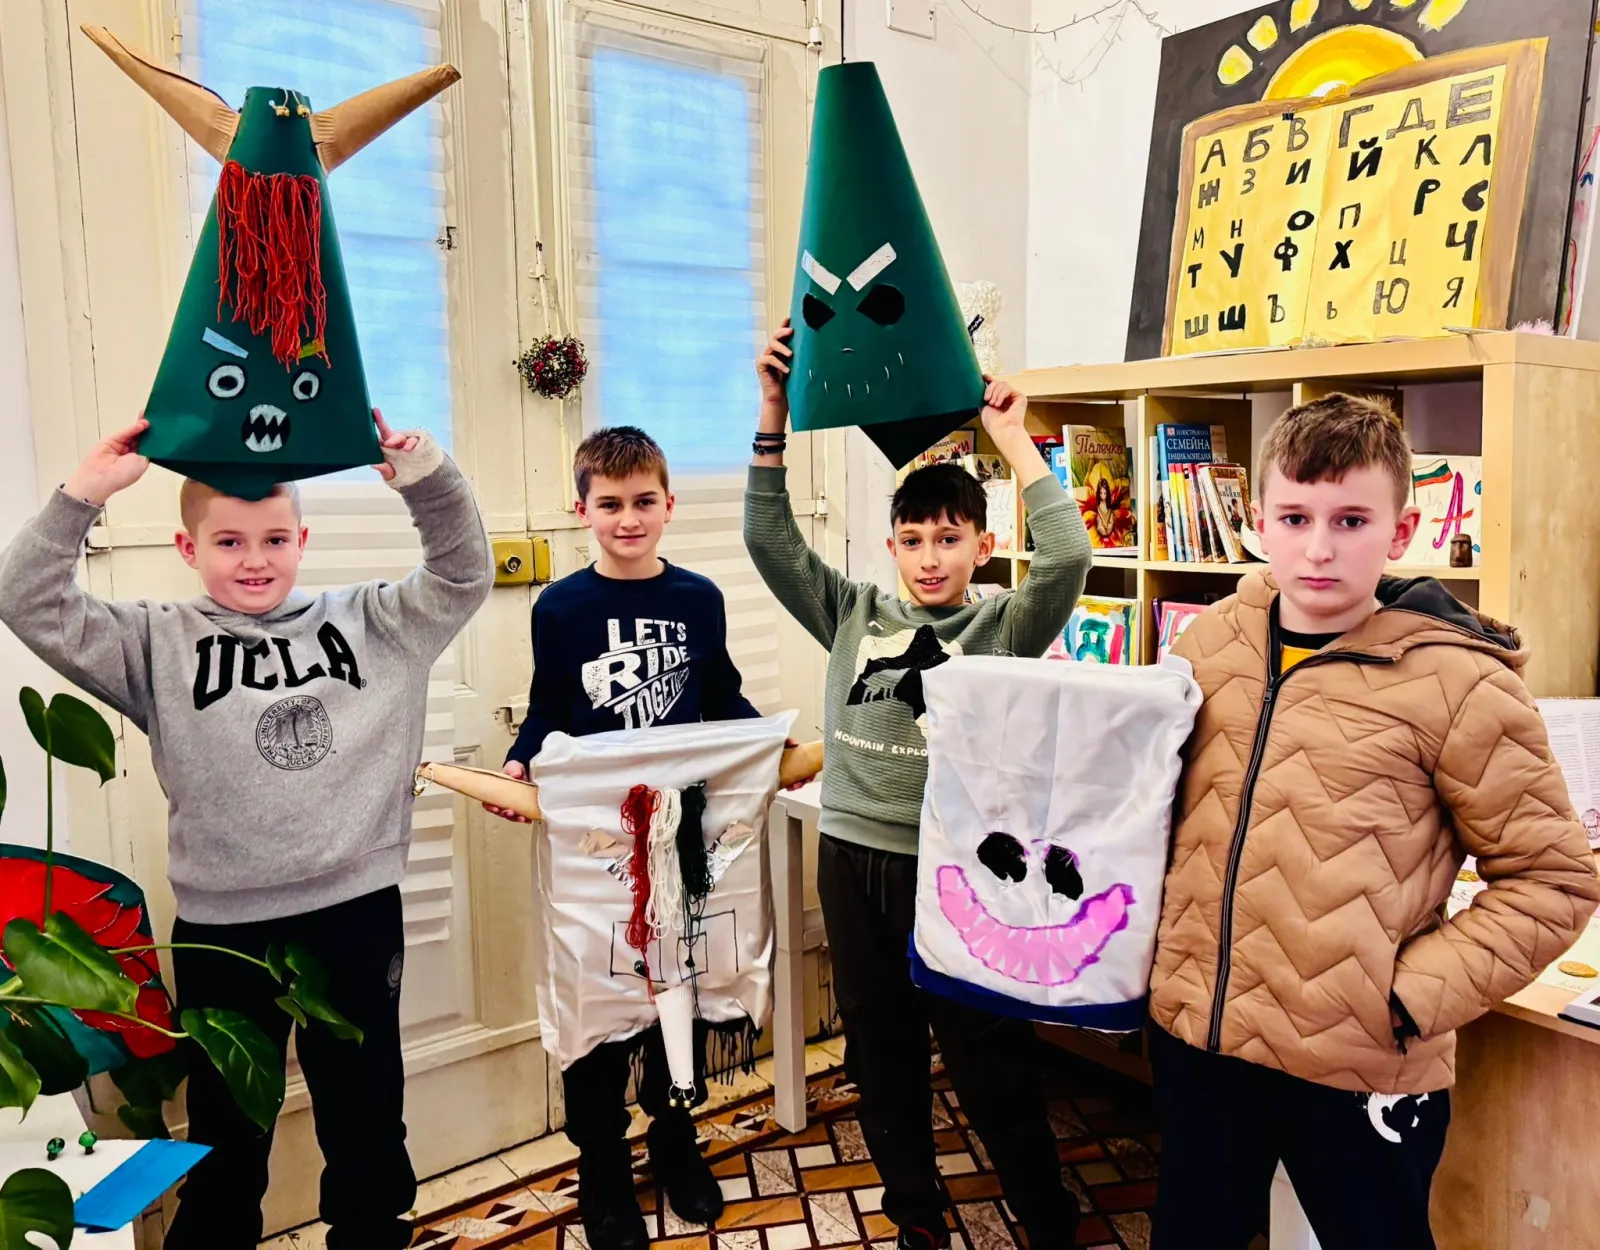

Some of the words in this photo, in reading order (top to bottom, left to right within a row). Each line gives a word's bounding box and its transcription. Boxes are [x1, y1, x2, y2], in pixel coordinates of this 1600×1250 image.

[1200, 139, 1226, 174] А
[1243, 125, 1274, 162] Б
[1287, 117, 1309, 152] В
[1338, 104, 1374, 149] Г
[1386, 98, 1435, 140] Д
[1446, 75, 1494, 129] Е
[1198, 178, 1220, 209] Ж
[1240, 168, 1256, 195] З
[1285, 159, 1311, 185] И
[1347, 136, 1383, 181] Й
[1414, 134, 1441, 169] К
[1459, 134, 1491, 166] Л
[1192, 226, 1204, 250] М
[1230, 219, 1242, 239] Н
[1287, 210, 1314, 231] О
[1338, 202, 1361, 230] П
[1413, 179, 1441, 216] Р
[1187, 263, 1203, 288] Т
[1219, 243, 1245, 278] У
[1274, 236, 1299, 271] Ф
[1328, 239, 1354, 270] Х
[1389, 238, 1407, 266] Ц
[1445, 220, 1478, 261] Ч
[1184, 314, 1209, 339] Ш
[1267, 294, 1286, 323] Ъ
[1373, 277, 1410, 315] Ю
[1442, 276, 1464, 308] Я
[1166, 436, 1211, 450] СЕМЕЙНА
[193, 621, 361, 711] UCLA
[607, 618, 687, 651] LET'S
[582, 646, 690, 710] RIDE
[261, 699, 295, 740] UNIVERSITY
[314, 704, 329, 748] ALIFORNIA
[834, 730, 884, 752] MOUNTAIN
[264, 744, 278, 760] THE
